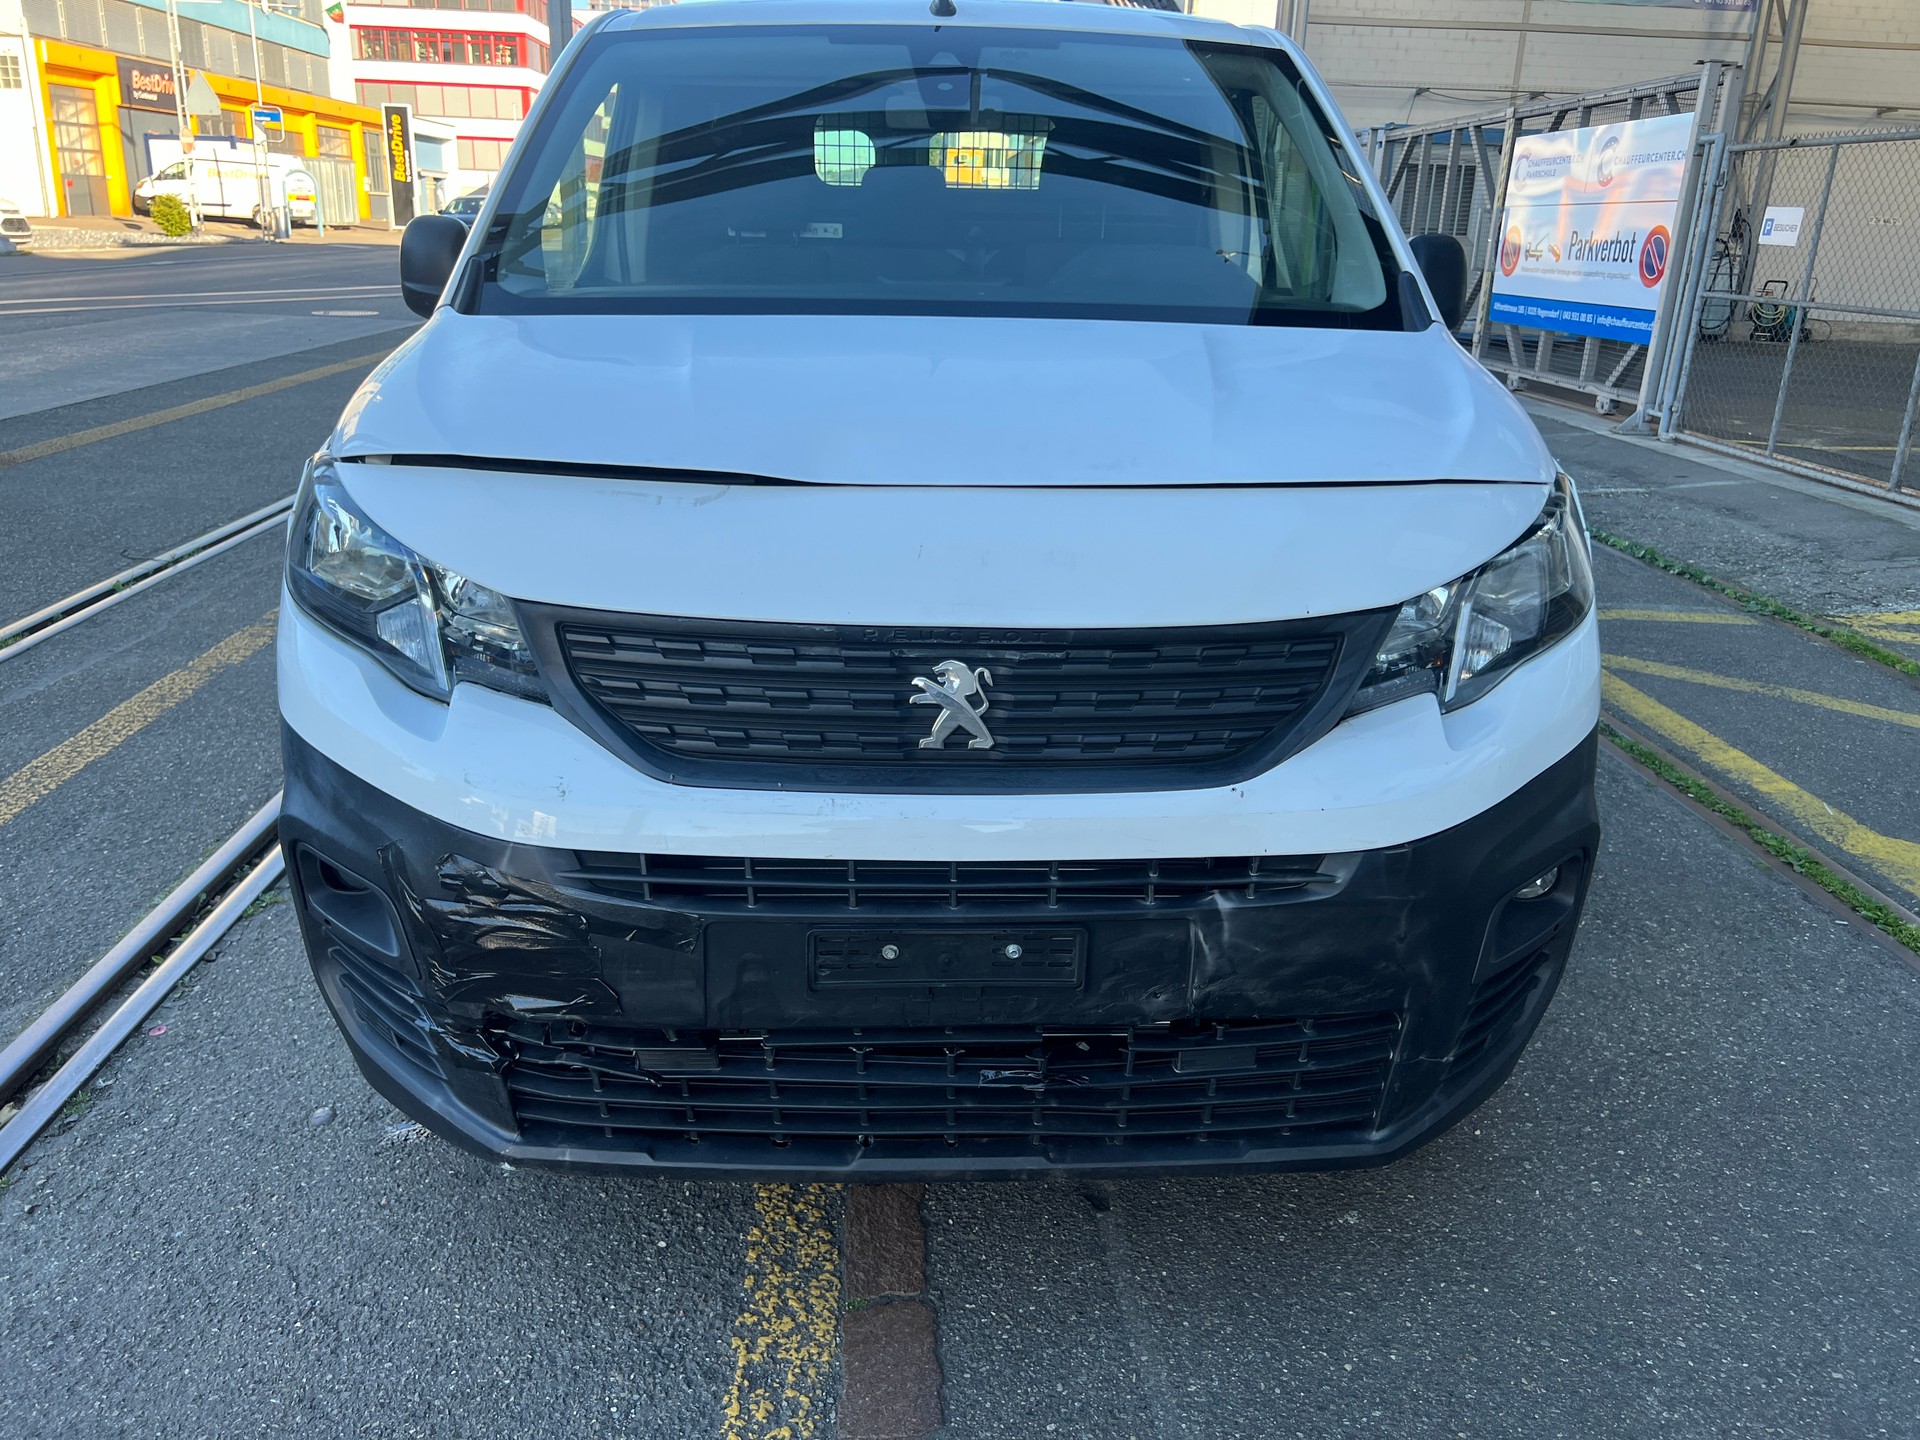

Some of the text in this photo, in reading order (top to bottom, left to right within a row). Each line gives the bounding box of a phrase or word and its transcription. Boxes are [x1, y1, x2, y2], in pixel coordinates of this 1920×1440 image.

[132, 69, 177, 95] BestDriv
[388, 114, 407, 182] BestDrive
[1567, 230, 1637, 263] Parkverbot
